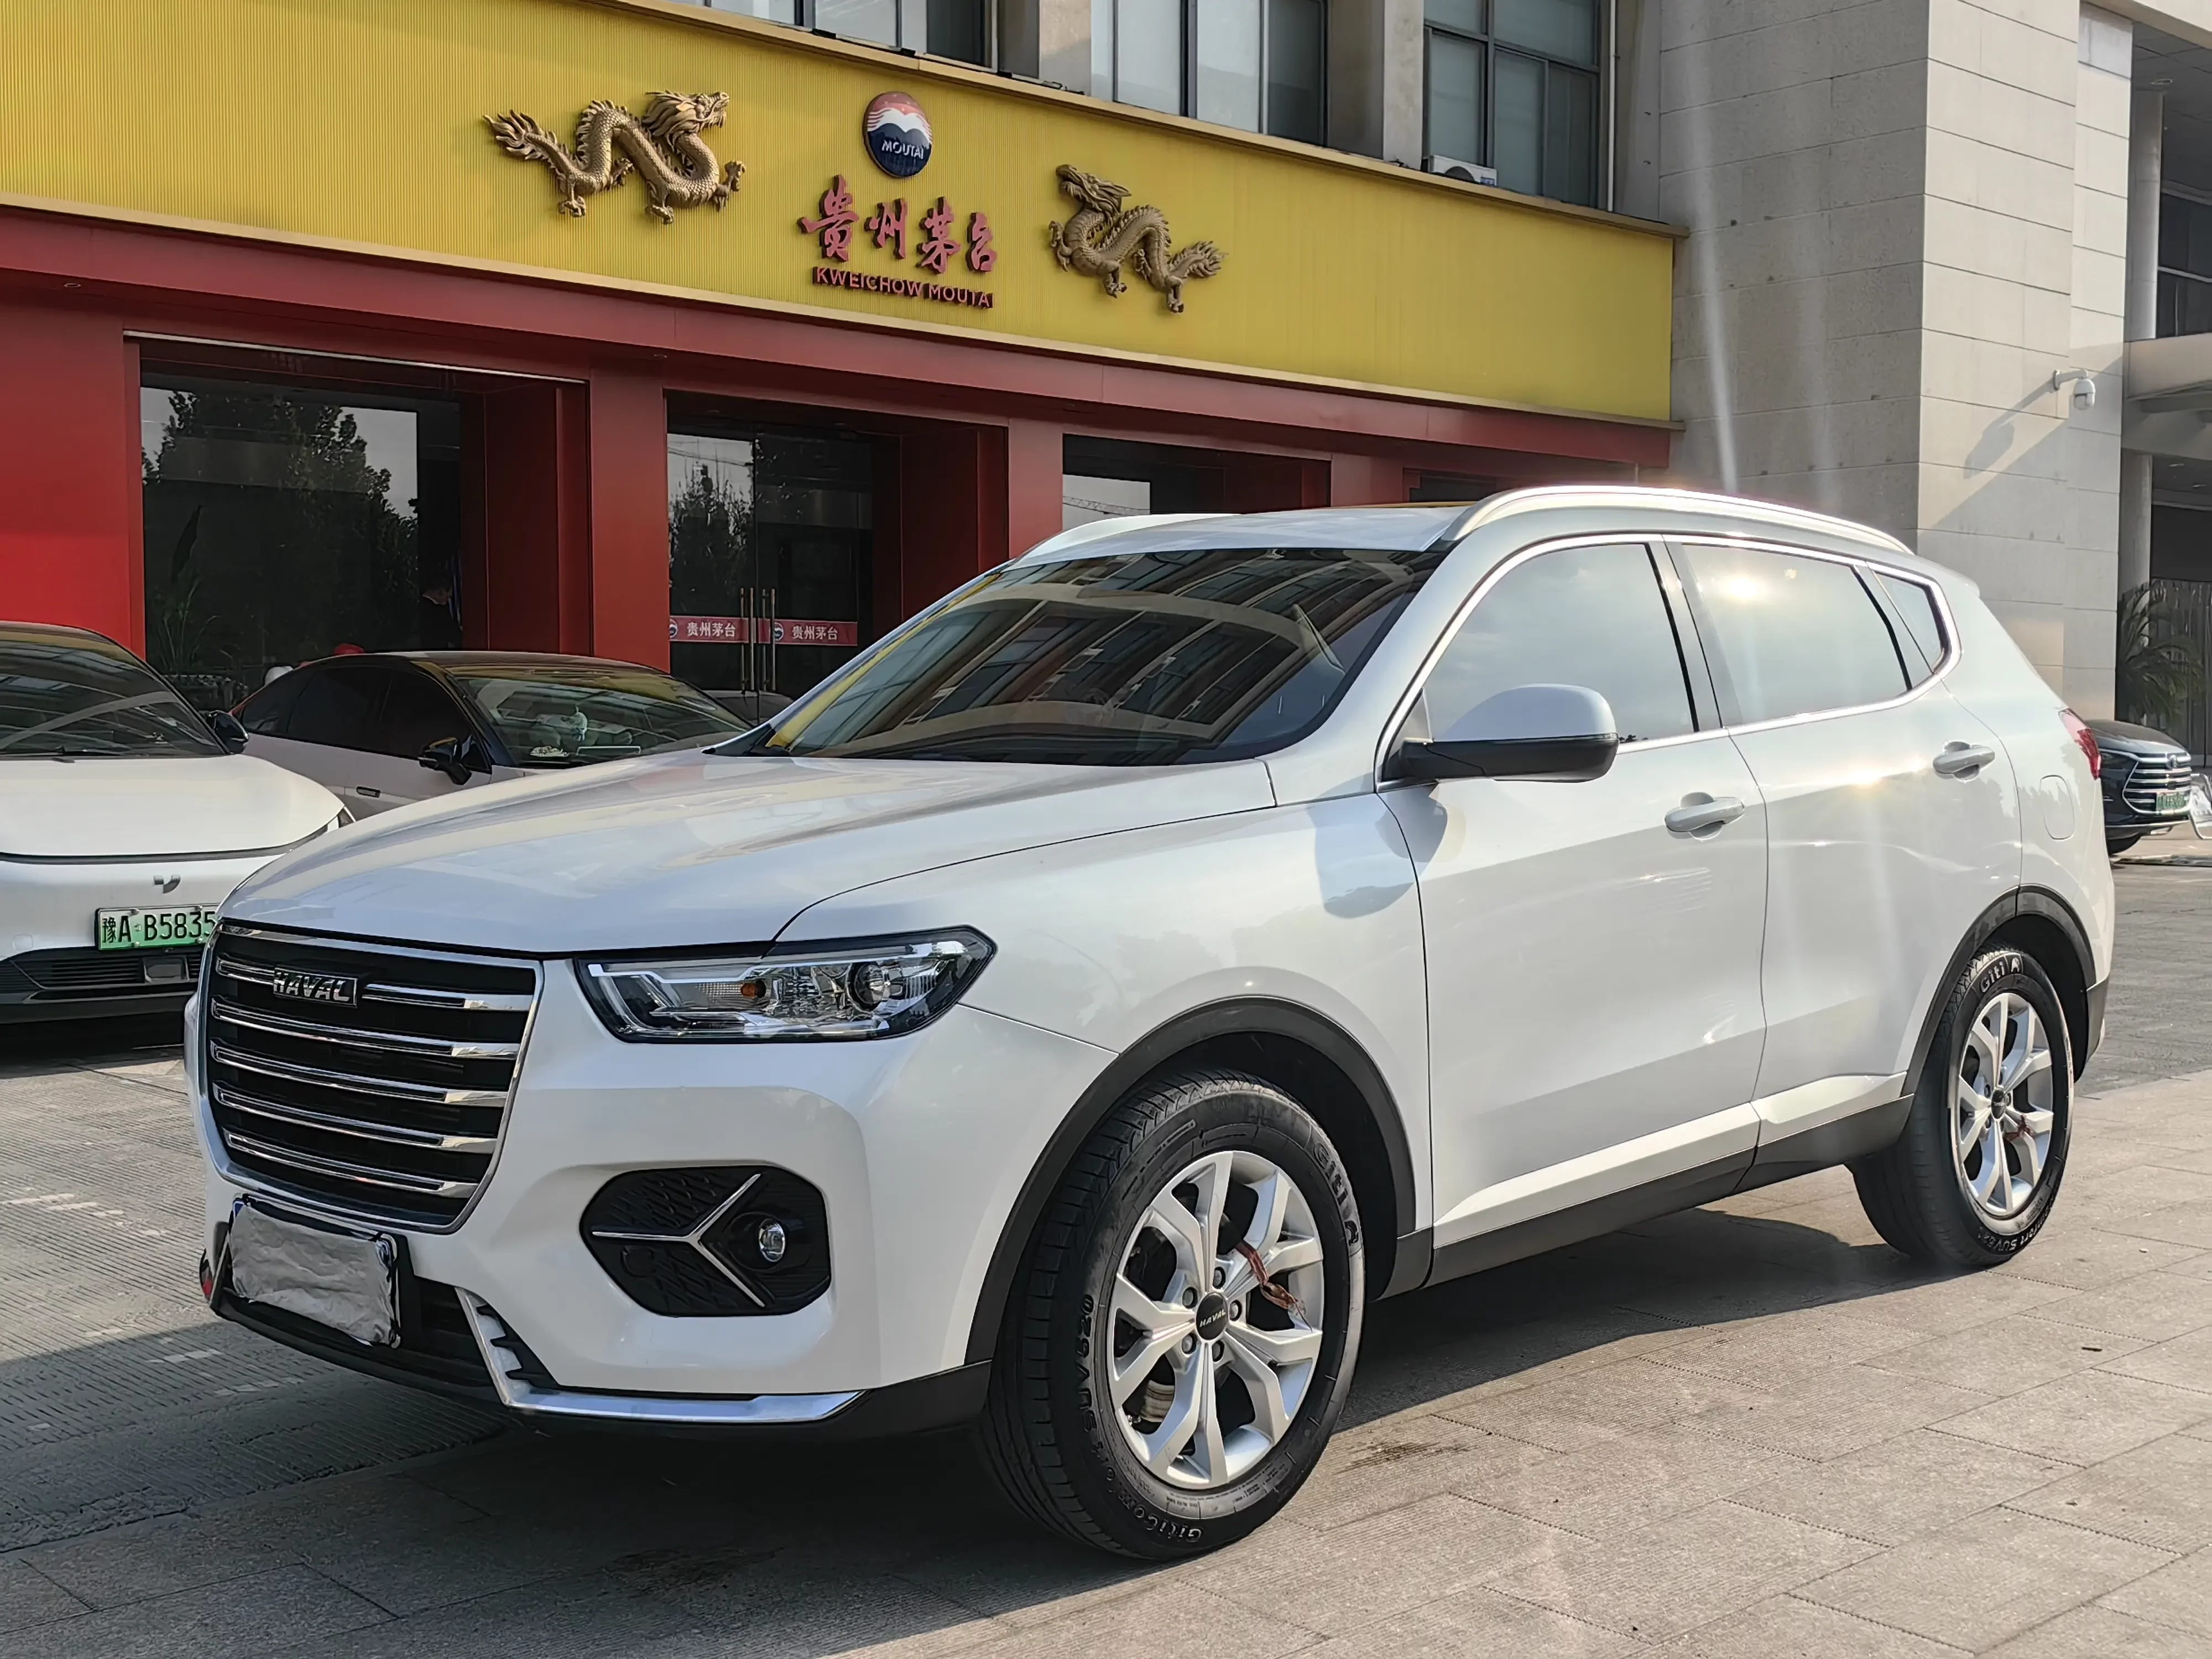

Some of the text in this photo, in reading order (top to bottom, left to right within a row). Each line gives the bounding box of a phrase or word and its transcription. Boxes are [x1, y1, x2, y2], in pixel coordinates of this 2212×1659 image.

[881, 139, 924, 160] MOUTAI
[797, 174, 997, 275] 贵州茅台
[813, 267, 924, 298] KWEICHOW
[687, 622, 736, 637] 贵州茅台
[792, 625, 838, 640] 贵州茅台
[274, 972, 350, 1001] HAVAL
[1199, 1308, 1227, 1327] HAVAL
